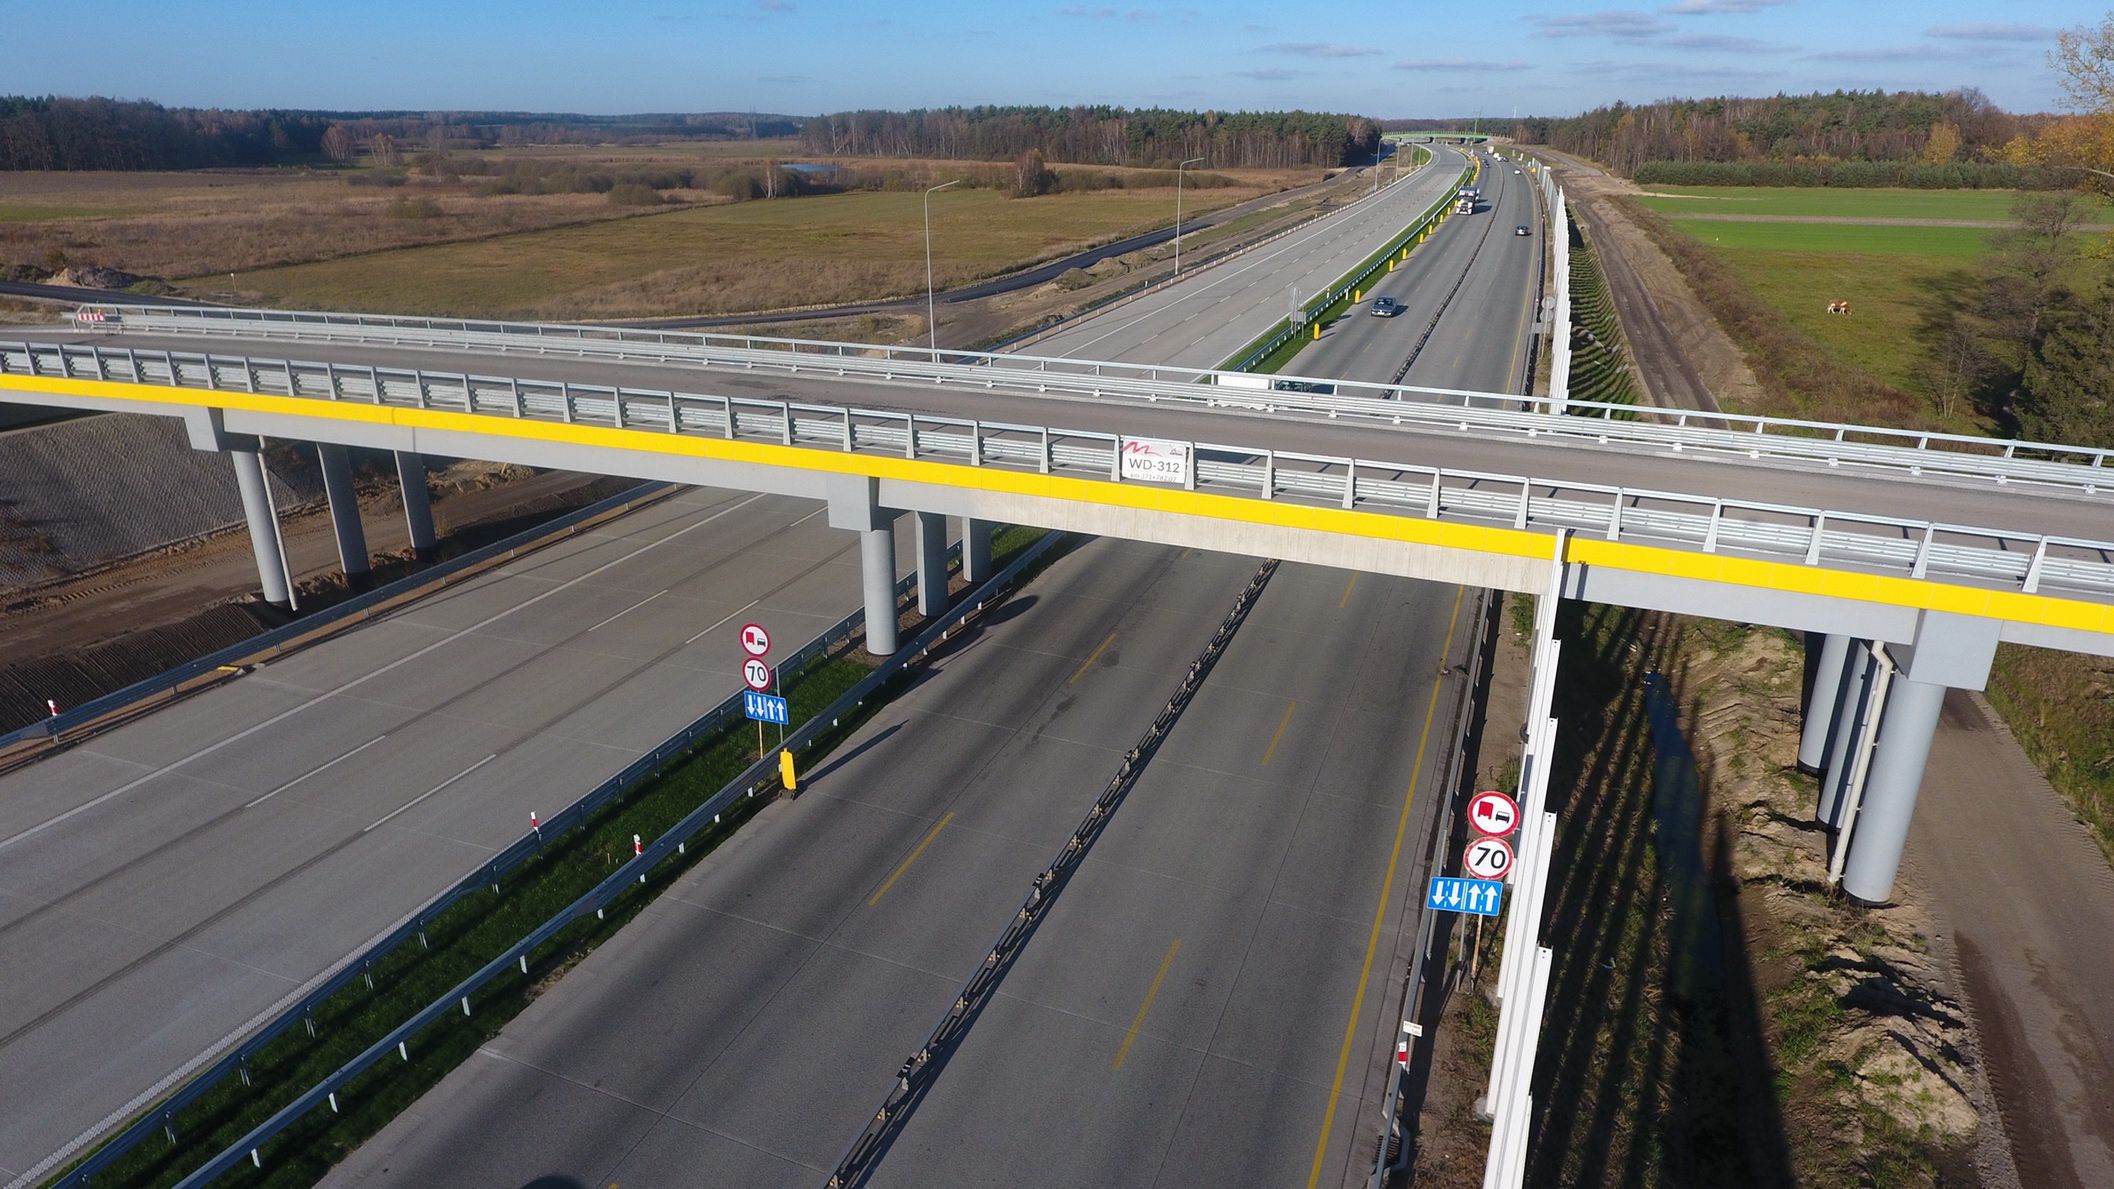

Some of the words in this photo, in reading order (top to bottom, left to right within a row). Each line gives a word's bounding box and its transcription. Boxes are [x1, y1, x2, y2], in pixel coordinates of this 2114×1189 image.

[1129, 458, 1180, 474] WD-312
[747, 665, 767, 682] 70
[1474, 846, 1506, 869] 70
